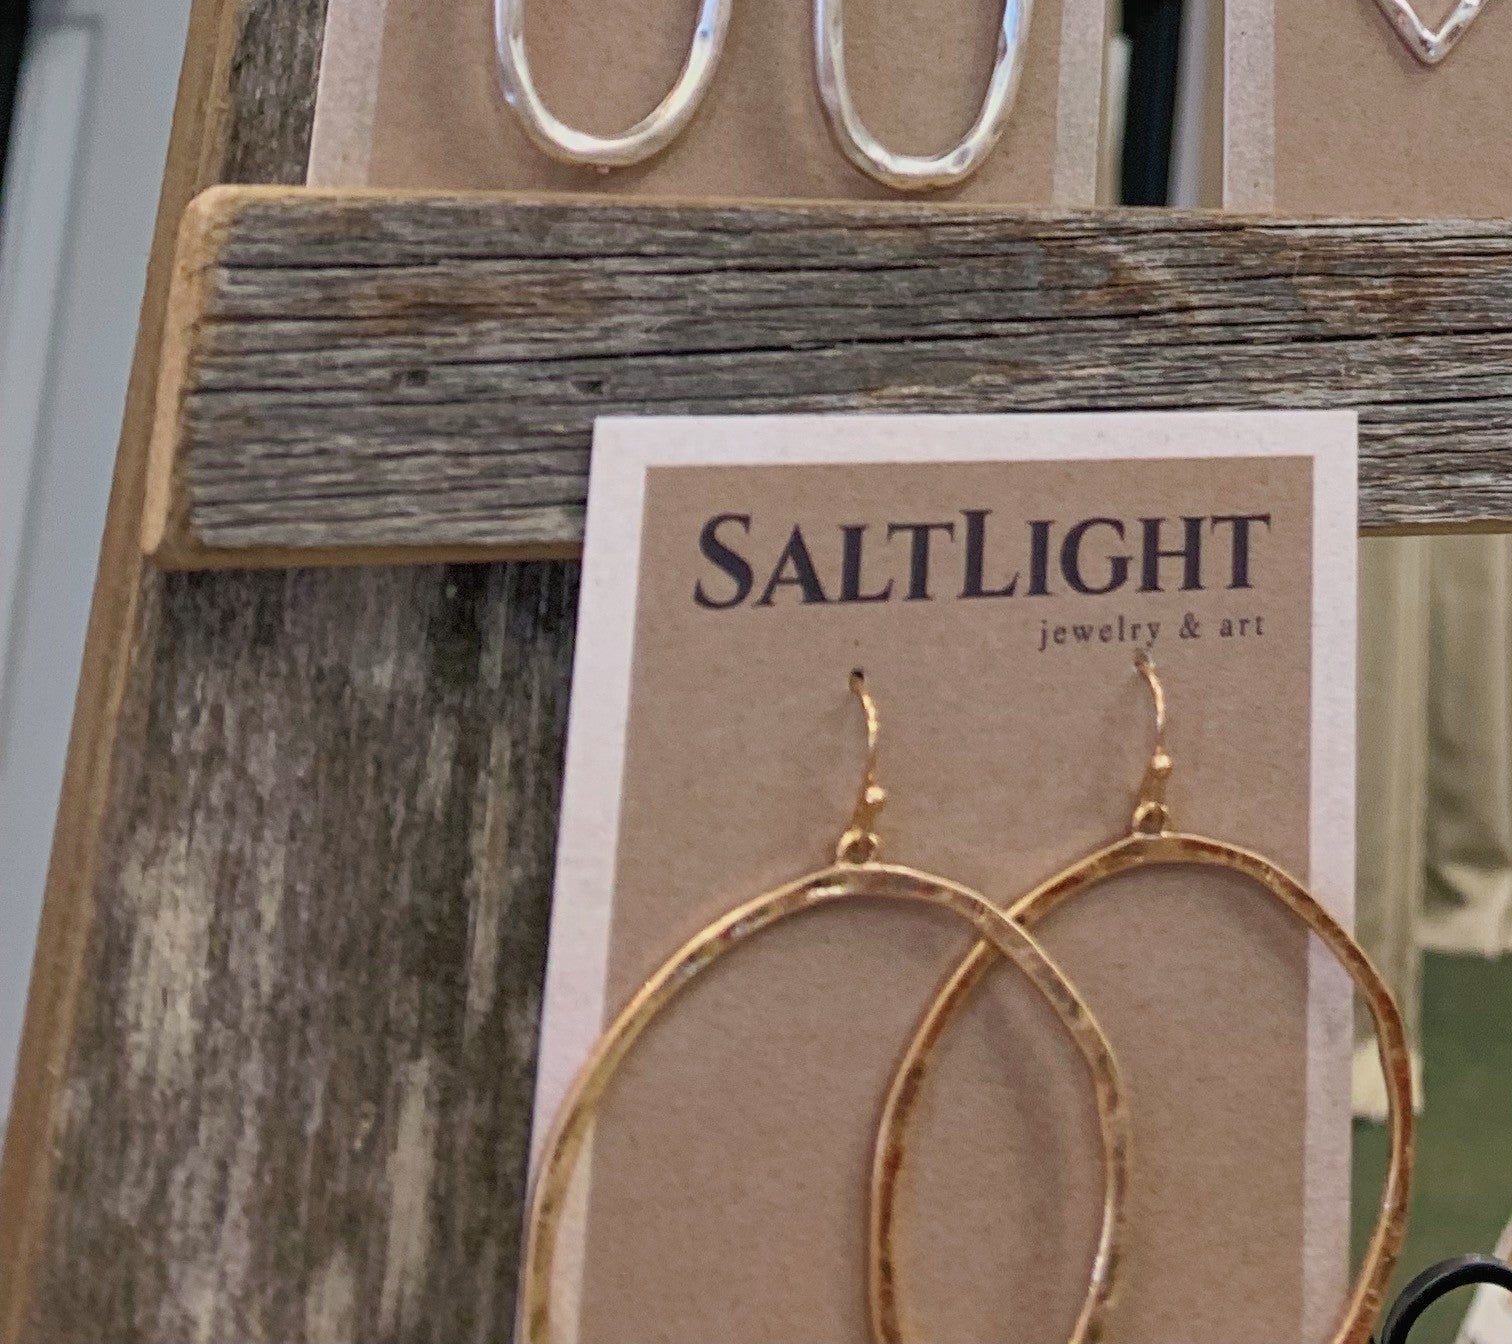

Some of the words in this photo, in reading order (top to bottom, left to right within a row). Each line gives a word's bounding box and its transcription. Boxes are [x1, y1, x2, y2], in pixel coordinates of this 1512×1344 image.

[1038, 613, 1162, 652] jewelry
[1177, 612, 1201, 640] &
[1219, 615, 1266, 639] art
